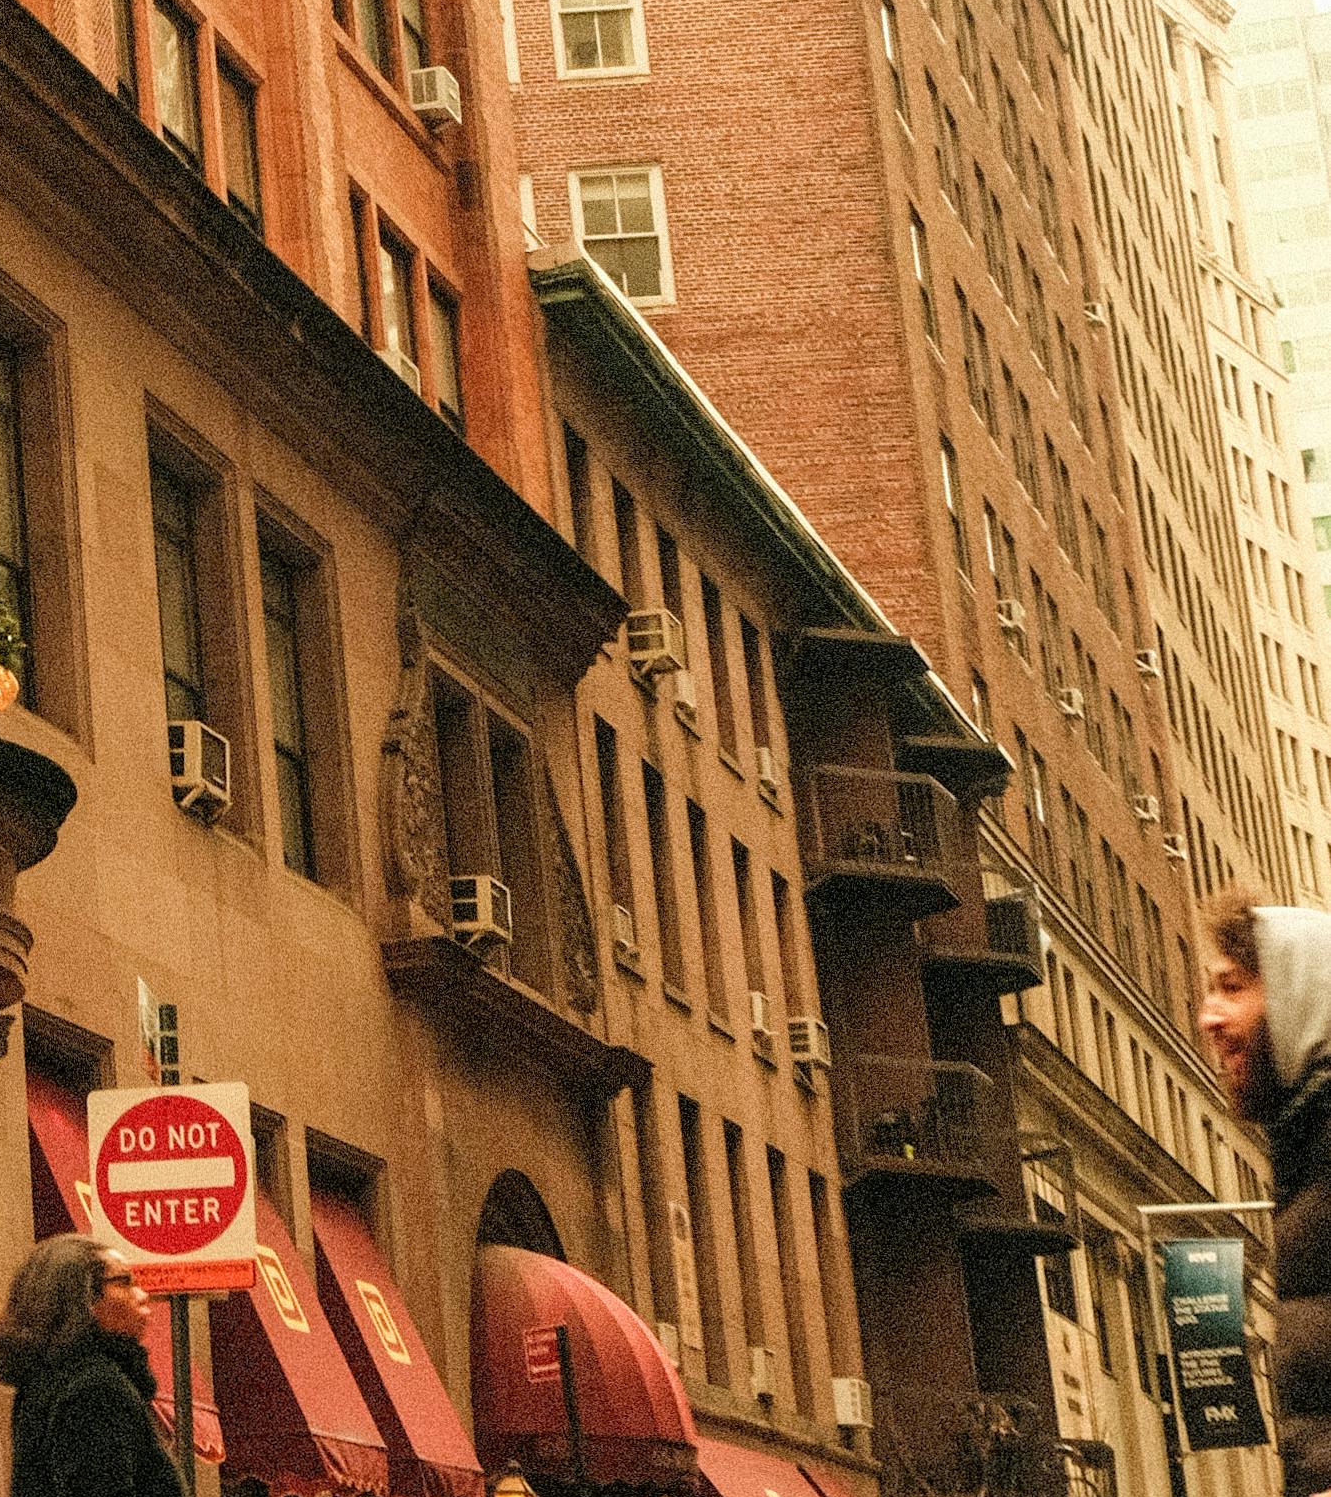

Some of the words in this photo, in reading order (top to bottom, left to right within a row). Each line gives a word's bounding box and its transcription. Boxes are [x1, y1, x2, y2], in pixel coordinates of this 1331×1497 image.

[119, 1125, 156, 1154] DO
[167, 1121, 222, 1151] NOT
[124, 1196, 222, 1228] ENTER
